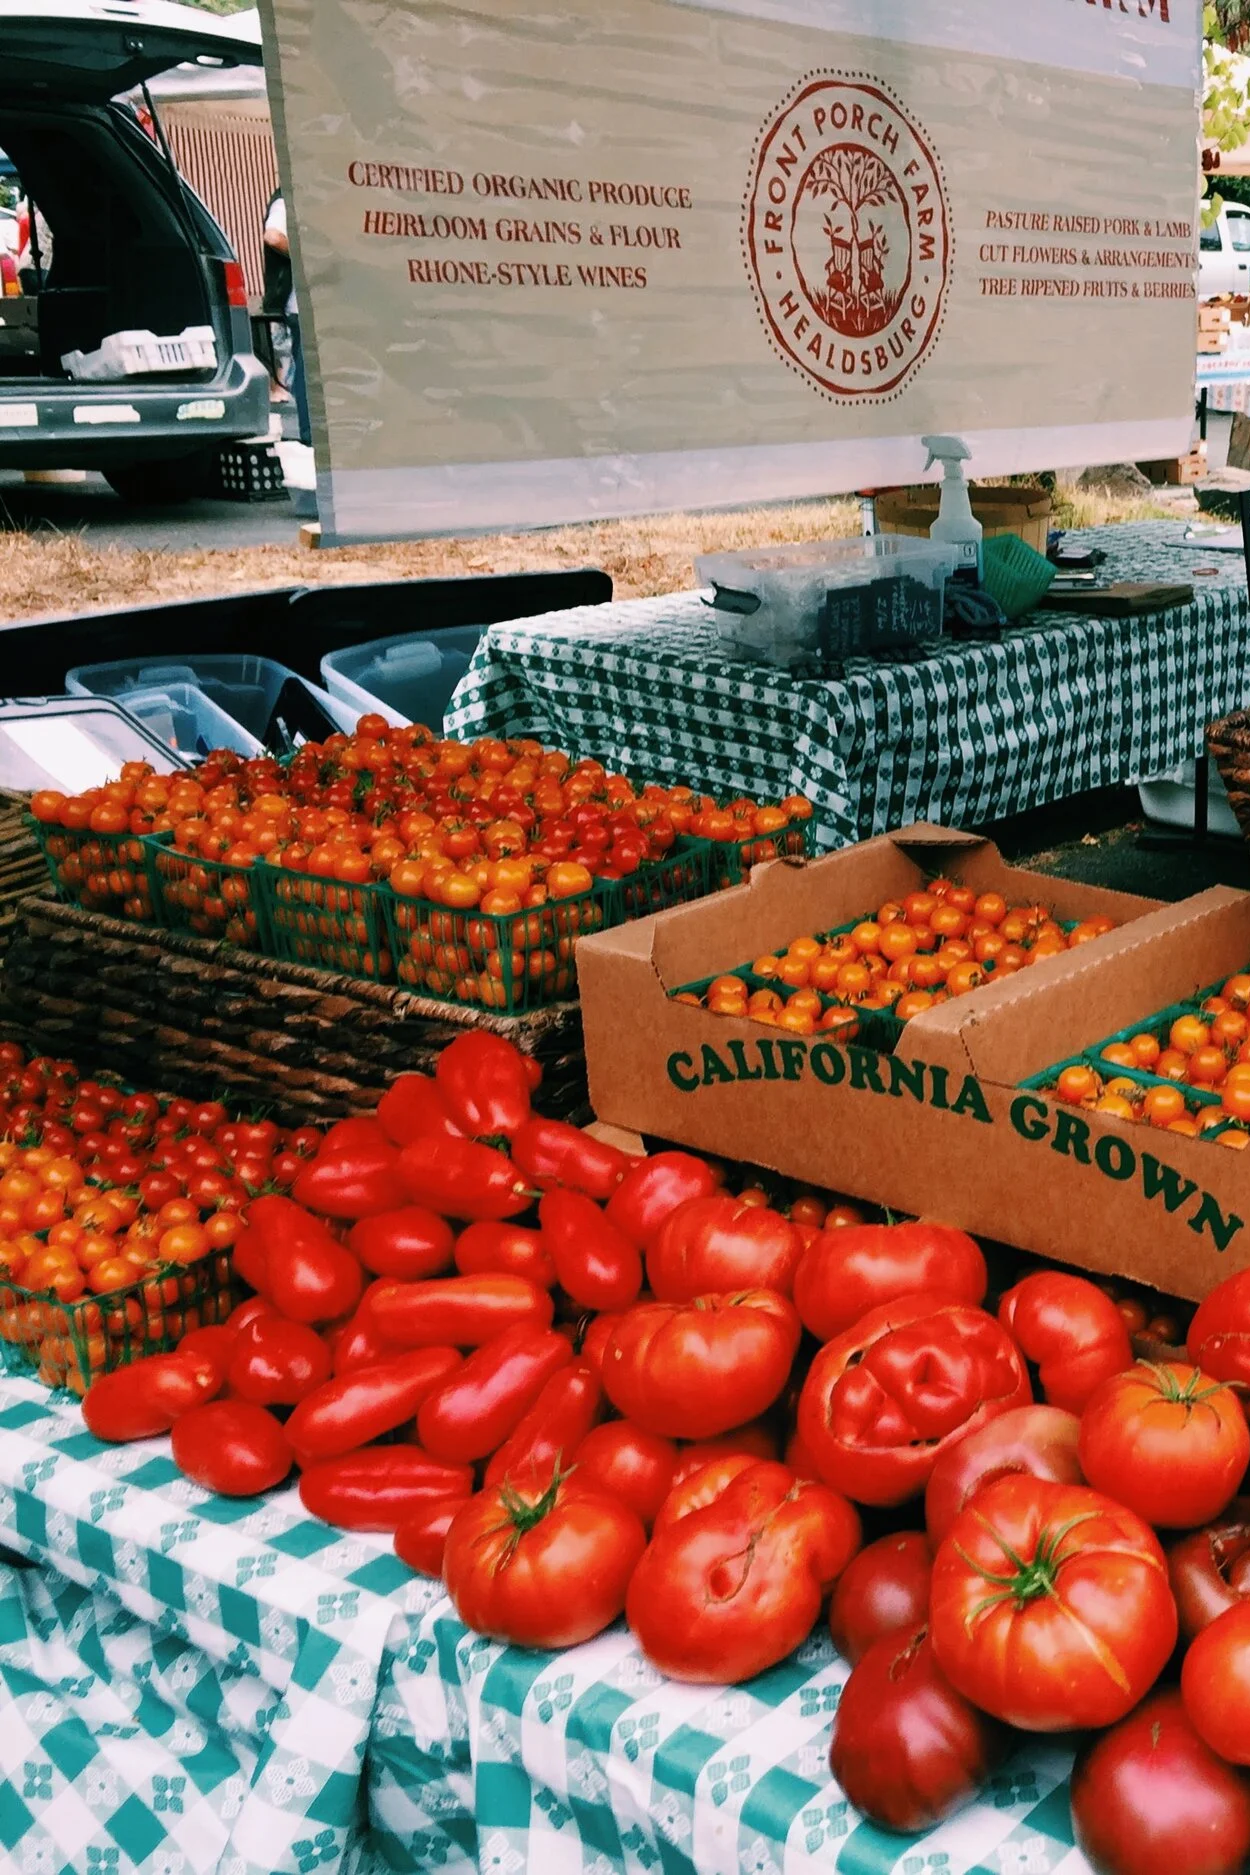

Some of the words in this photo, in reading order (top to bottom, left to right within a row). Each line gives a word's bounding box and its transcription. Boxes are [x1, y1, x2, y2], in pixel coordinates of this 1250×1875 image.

[348, 160, 464, 195] CERTIFIED
[472, 172, 582, 202] ORGANIC
[588, 181, 692, 209] PRODUCE
[764, 124, 808, 256] FRONT
[812, 101, 900, 155] PORCH
[903, 158, 936, 262] FARM
[363, 210, 488, 241] HEIRLOOM
[495, 218, 582, 245] GRAINS
[590, 226, 604, 245] &
[609, 224, 681, 249] FLOUR
[985, 210, 1049, 232] PASTURE
[1053, 214, 1100, 235] RAISED
[1103, 218, 1140, 236] PORK
[1143, 222, 1152, 237] &
[1155, 220, 1191, 239] LAMB
[407, 258, 572, 287] RHONE-STYLE
[577, 265, 647, 289] WINES
[979, 243, 1009, 263] CUT
[1012, 245, 1077, 265] FLOWERS
[1081, 251, 1090, 266] &
[1094, 250, 1198, 268] ARRANGEMENTS
[979, 277, 1017, 296] TREE
[1021, 279, 1080, 297] RIPENED
[1083, 280, 1128, 298] FRUITS
[1131, 283, 1139, 298] &
[1143, 282, 1196, 299] BERRIES
[779, 289, 926, 376] HEALDSBURG
[667, 1039, 994, 1125] CALIFORNIA
[1009, 1095, 1245, 1252] GROWN
